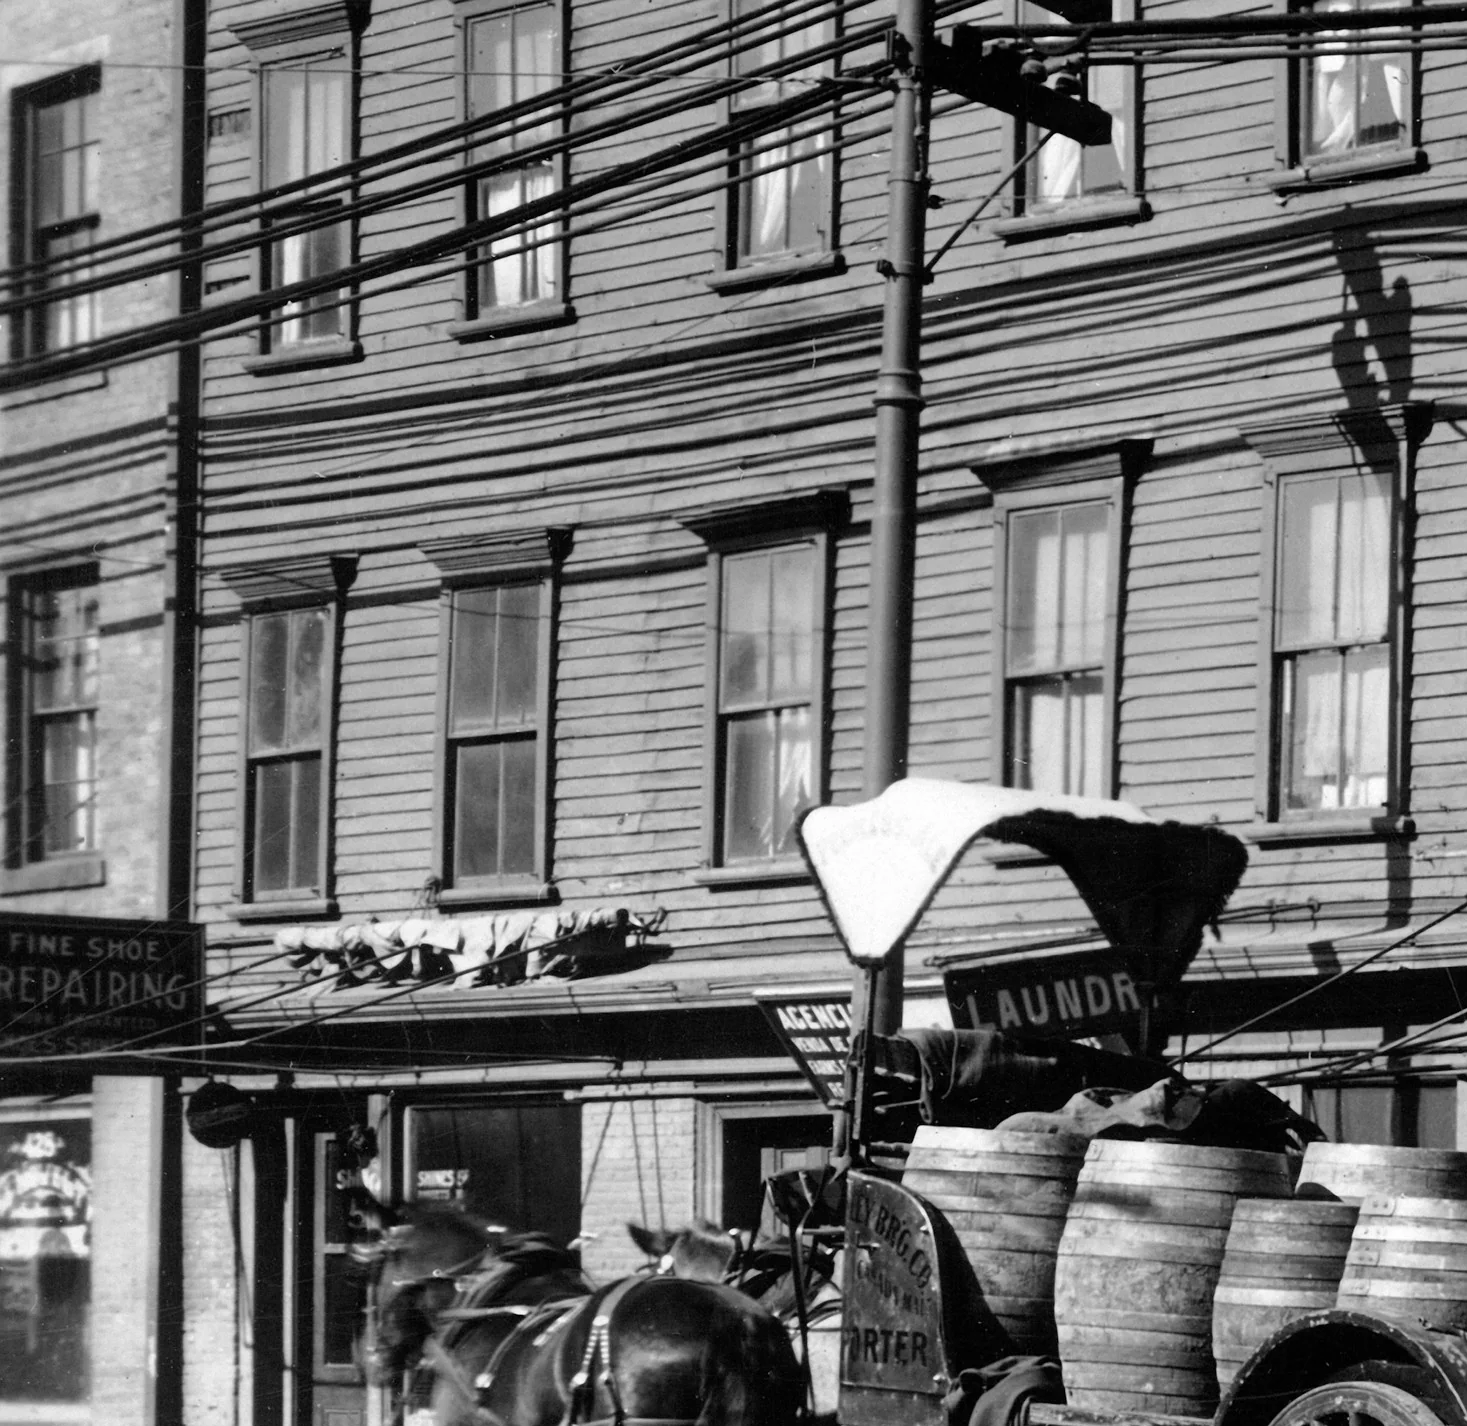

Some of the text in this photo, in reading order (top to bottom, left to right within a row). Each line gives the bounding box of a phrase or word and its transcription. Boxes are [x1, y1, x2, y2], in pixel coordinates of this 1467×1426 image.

[10, 932, 162, 962] FINE SHOE
[0, 966, 187, 1011] REPAIRING
[966, 972, 1141, 1030] LAUNDR
[849, 1326, 928, 1368] ORTER
